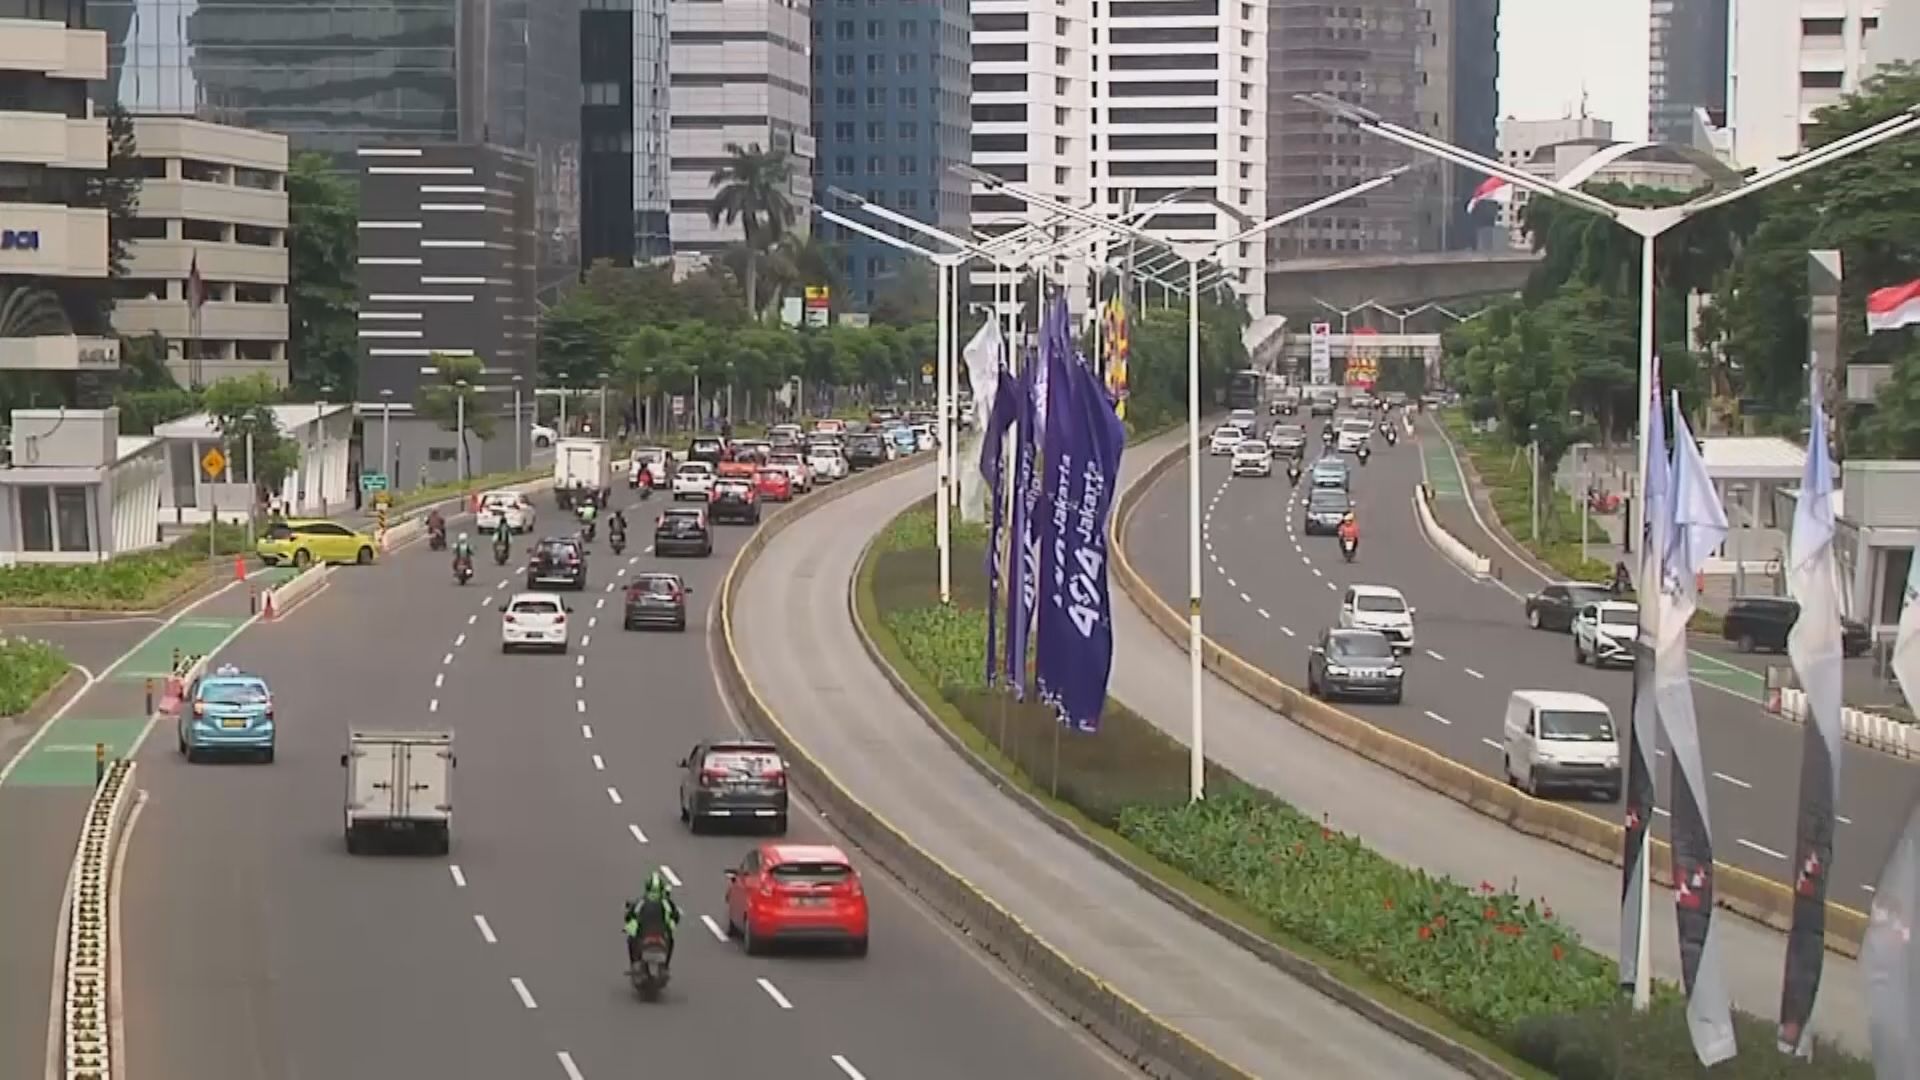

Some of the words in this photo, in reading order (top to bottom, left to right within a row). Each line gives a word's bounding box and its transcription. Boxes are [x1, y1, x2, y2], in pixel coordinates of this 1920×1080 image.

[1053, 454, 1071, 535] Jakarta
[1076, 461, 1101, 543] Jakarta
[1068, 547, 1102, 637] 494
